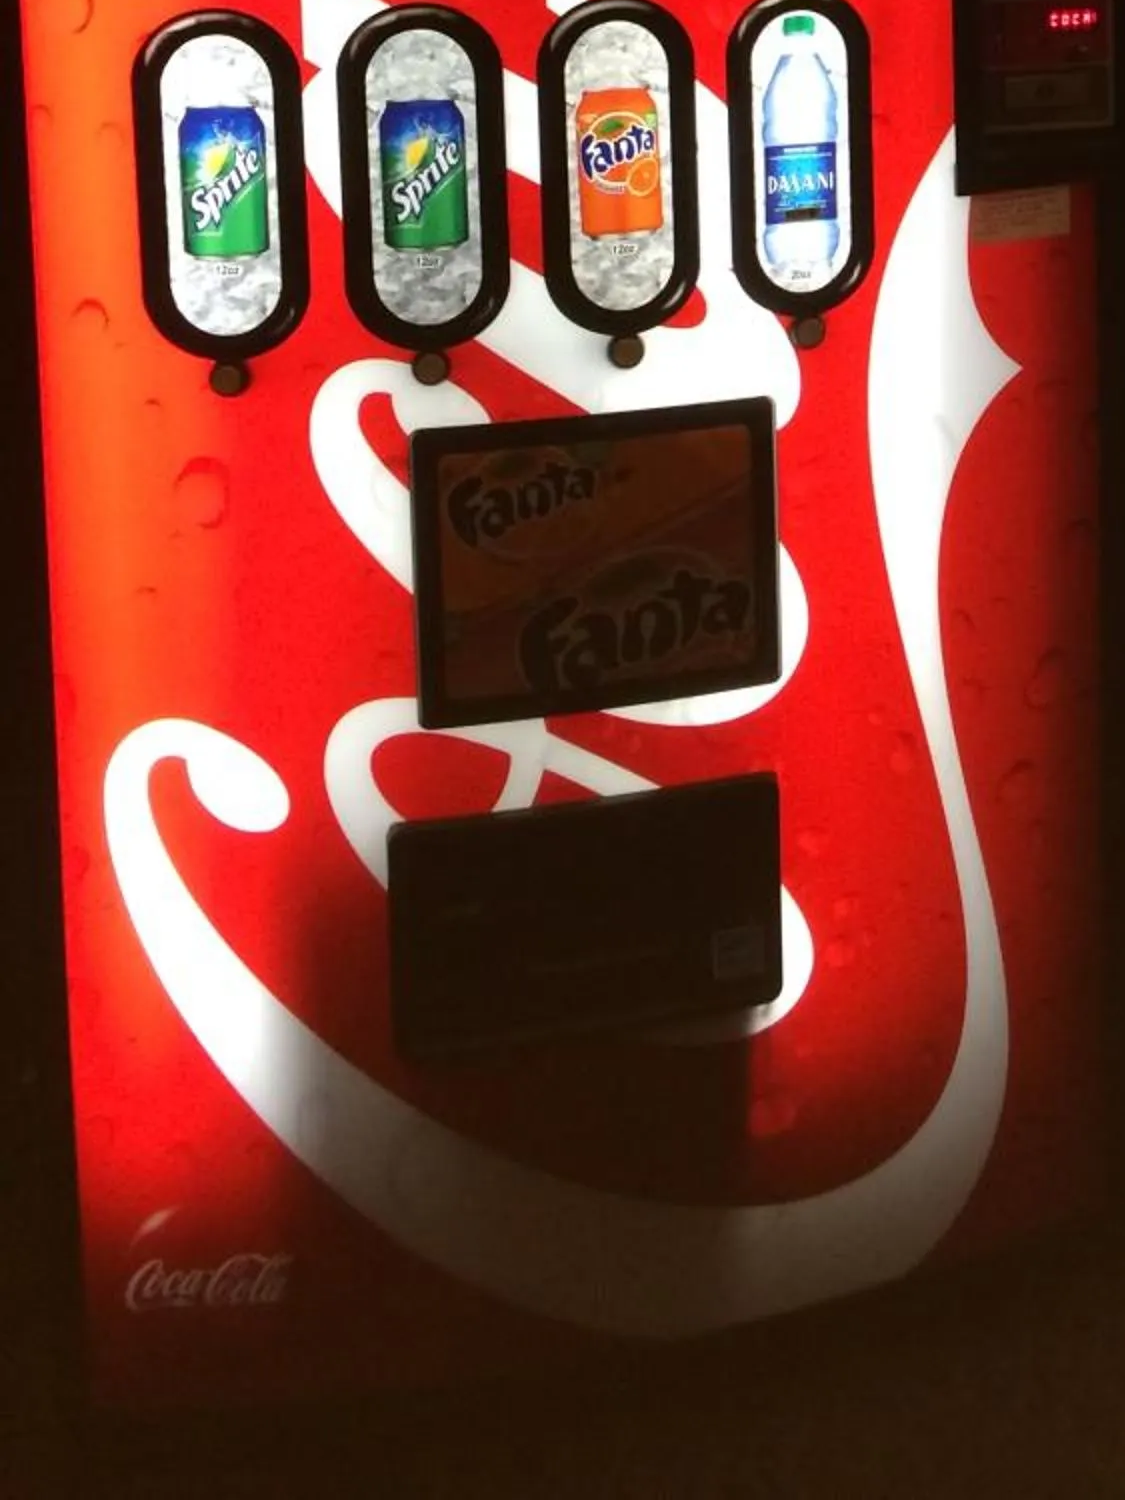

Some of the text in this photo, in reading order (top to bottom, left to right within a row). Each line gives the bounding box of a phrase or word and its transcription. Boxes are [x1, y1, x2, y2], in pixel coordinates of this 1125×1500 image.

[190, 145, 260, 231] Sprite
[391, 138, 461, 223] Sprite
[447, 460, 597, 550] Fanta
[518, 568, 752, 694] Fanta
[123, 1253, 296, 1314] Coca-Cola
